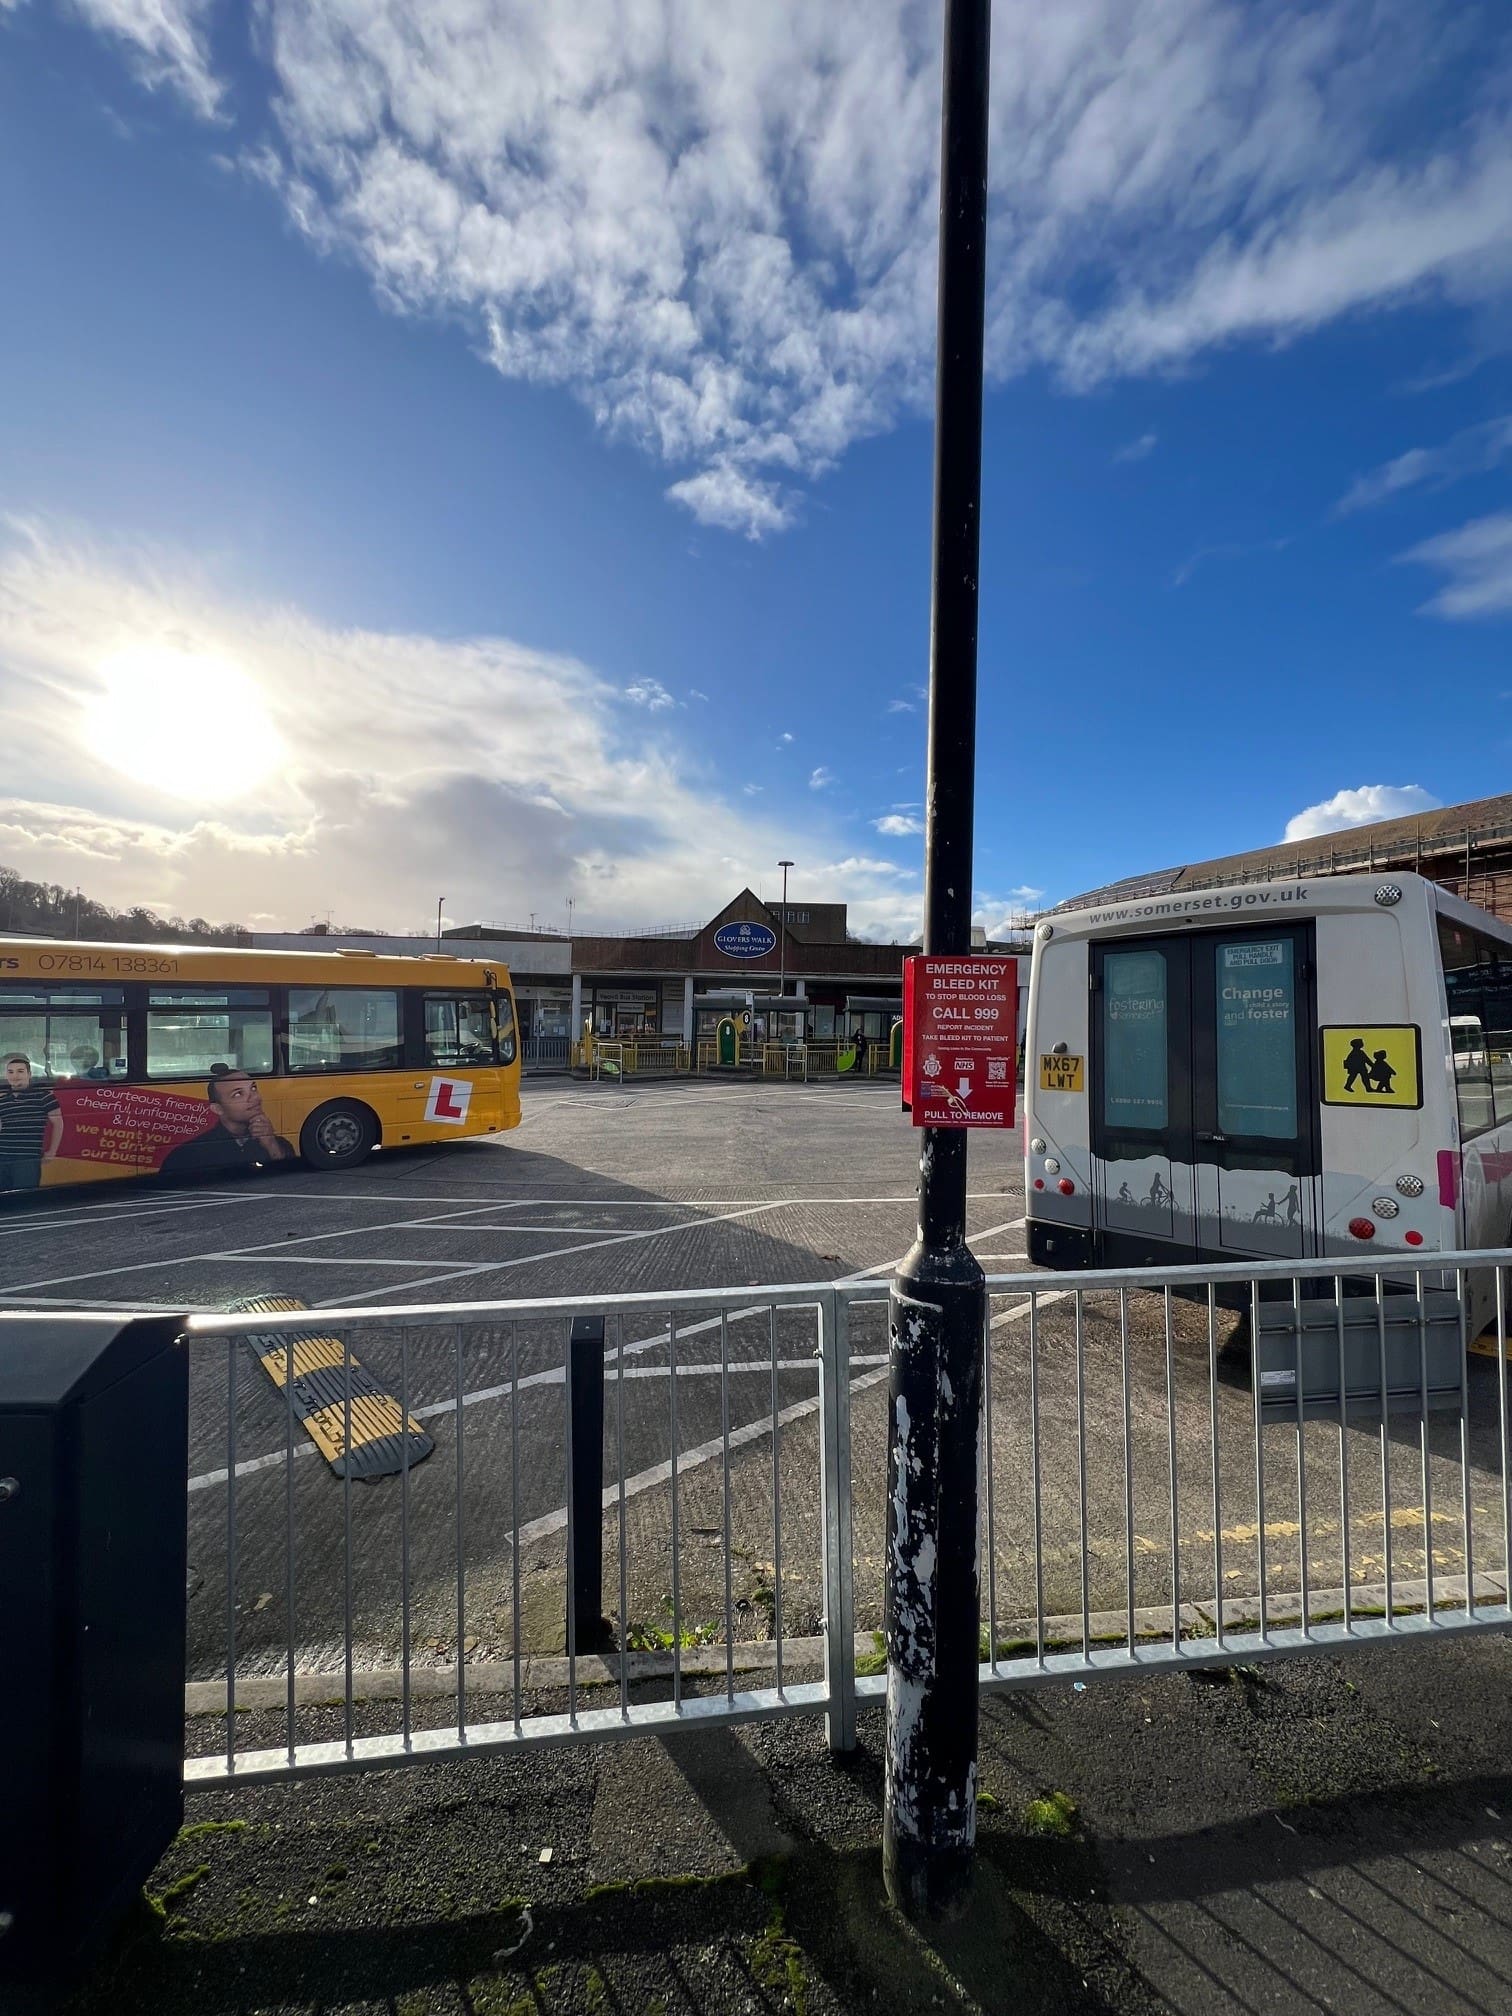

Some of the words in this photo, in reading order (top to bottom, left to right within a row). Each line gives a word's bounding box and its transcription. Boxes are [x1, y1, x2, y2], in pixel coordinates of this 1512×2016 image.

[1089, 886, 1308, 924] www.somerset.gov.uk
[38, 954, 106, 972] 07814
[111, 957, 179, 973] 138361
[925, 963, 1007, 975] EMERGENCY
[933, 978, 975, 990] BLEED
[979, 979, 1000, 990] KIT
[1222, 987, 1284, 1002] Change
[932, 1006, 971, 1019] CALL
[974, 1007, 999, 1020] 999
[1224, 1009, 1245, 1020] and
[1248, 1008, 1289, 1019] foster
[1043, 1056, 1080, 1071] MX67
[1047, 1073, 1075, 1088] LWT
[96, 1088, 162, 1107] courteous,
[165, 1097, 210, 1115] friendly,
[434, 1083, 462, 1118] L
[76, 1096, 131, 1114] cheerful,
[135, 1106, 209, 1126] unflappable,
[924, 1110, 948, 1119] PULL
[950, 1111, 962, 1119] TO
[964, 1112, 1004, 1120] REMOVE
[112, 1114, 123, 1125] &
[125, 1116, 151, 1129] love
[152, 1122, 200, 1136] people?
[76, 1123, 99, 1133] we
[103, 1127, 144, 1140] want
[146, 1133, 172, 1144] you
[100, 1137, 115, 1148] to
[119, 1138, 156, 1153] drive
[81, 1148, 109, 1159] our
[109, 1150, 153, 1163] buses
